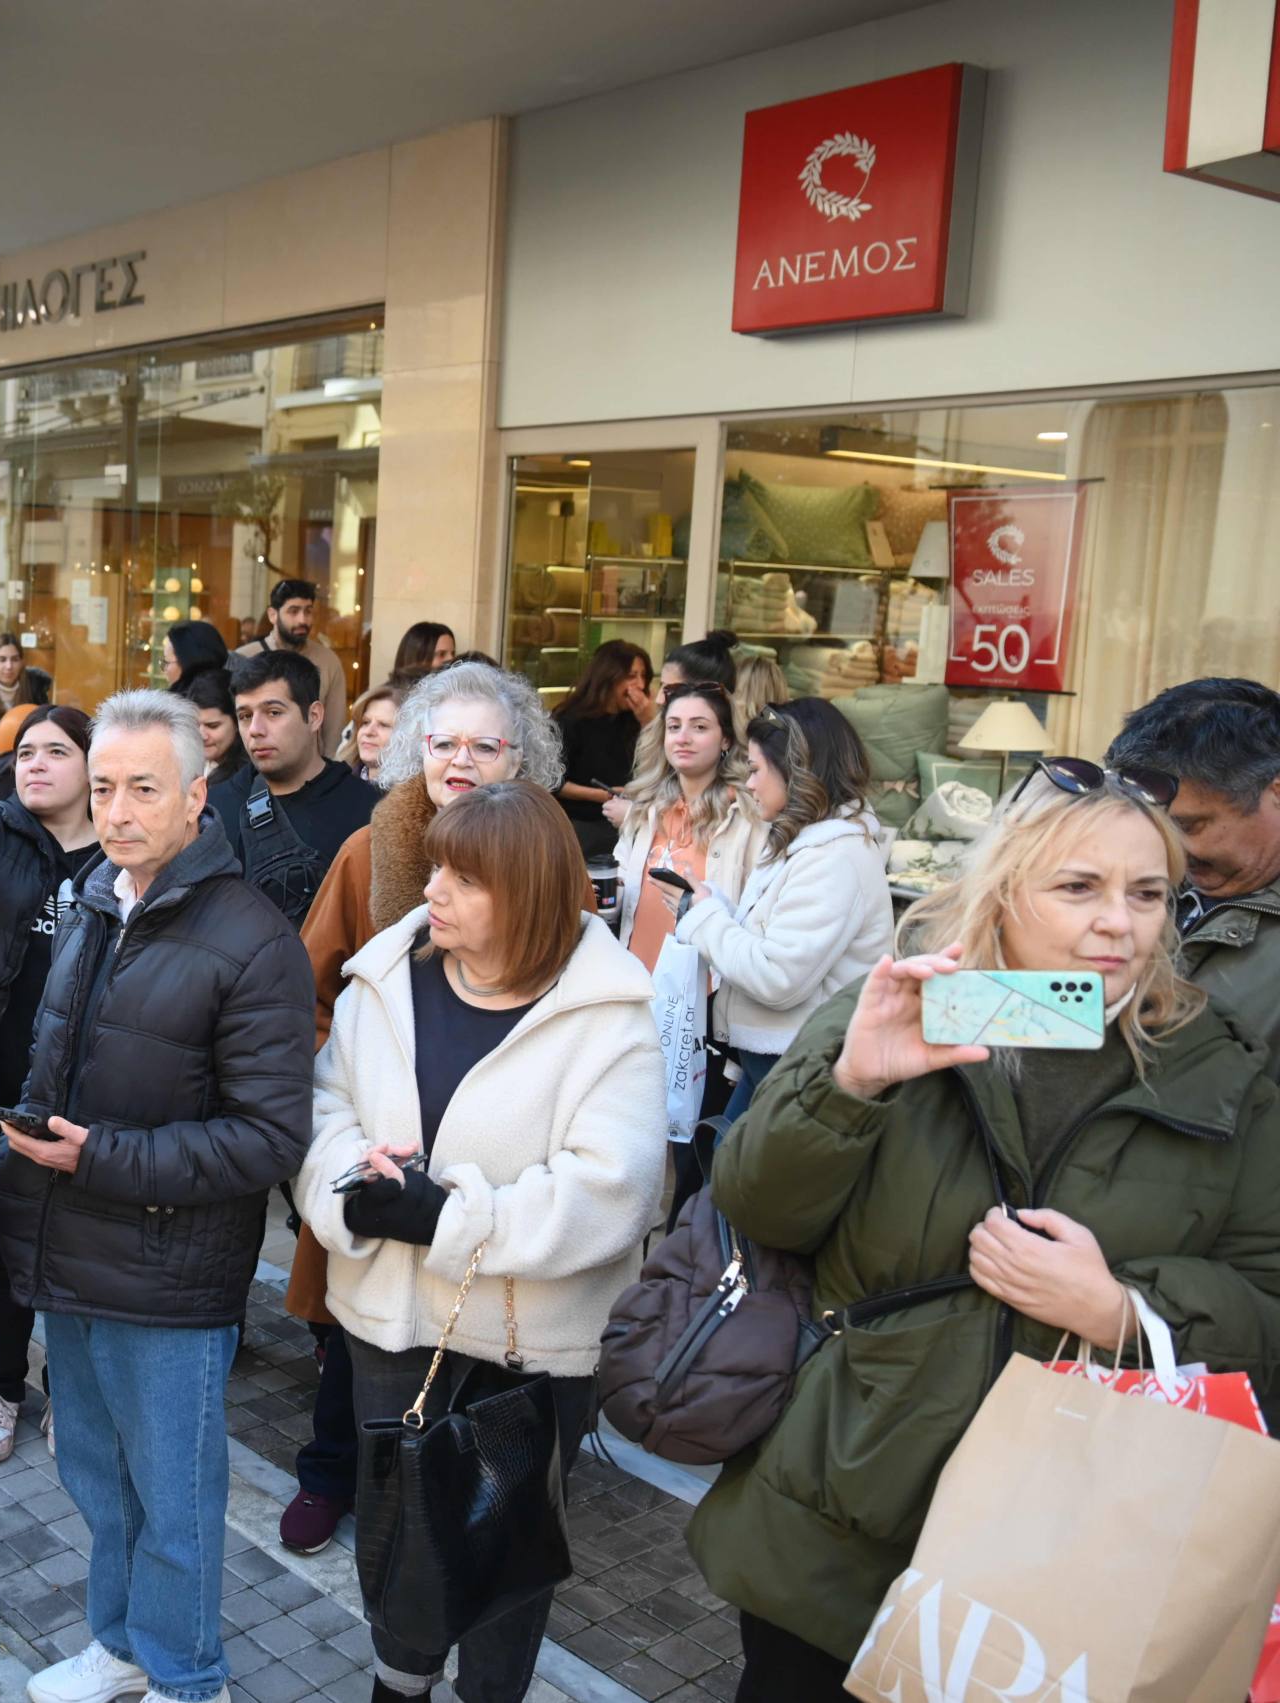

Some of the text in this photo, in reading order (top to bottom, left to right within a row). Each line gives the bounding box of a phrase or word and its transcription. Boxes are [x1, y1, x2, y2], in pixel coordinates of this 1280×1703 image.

[752, 237, 917, 291] ΑΝΕΜΟΣ
[972, 568, 1035, 586] SALES
[660, 995, 679, 1047] ONLINE
